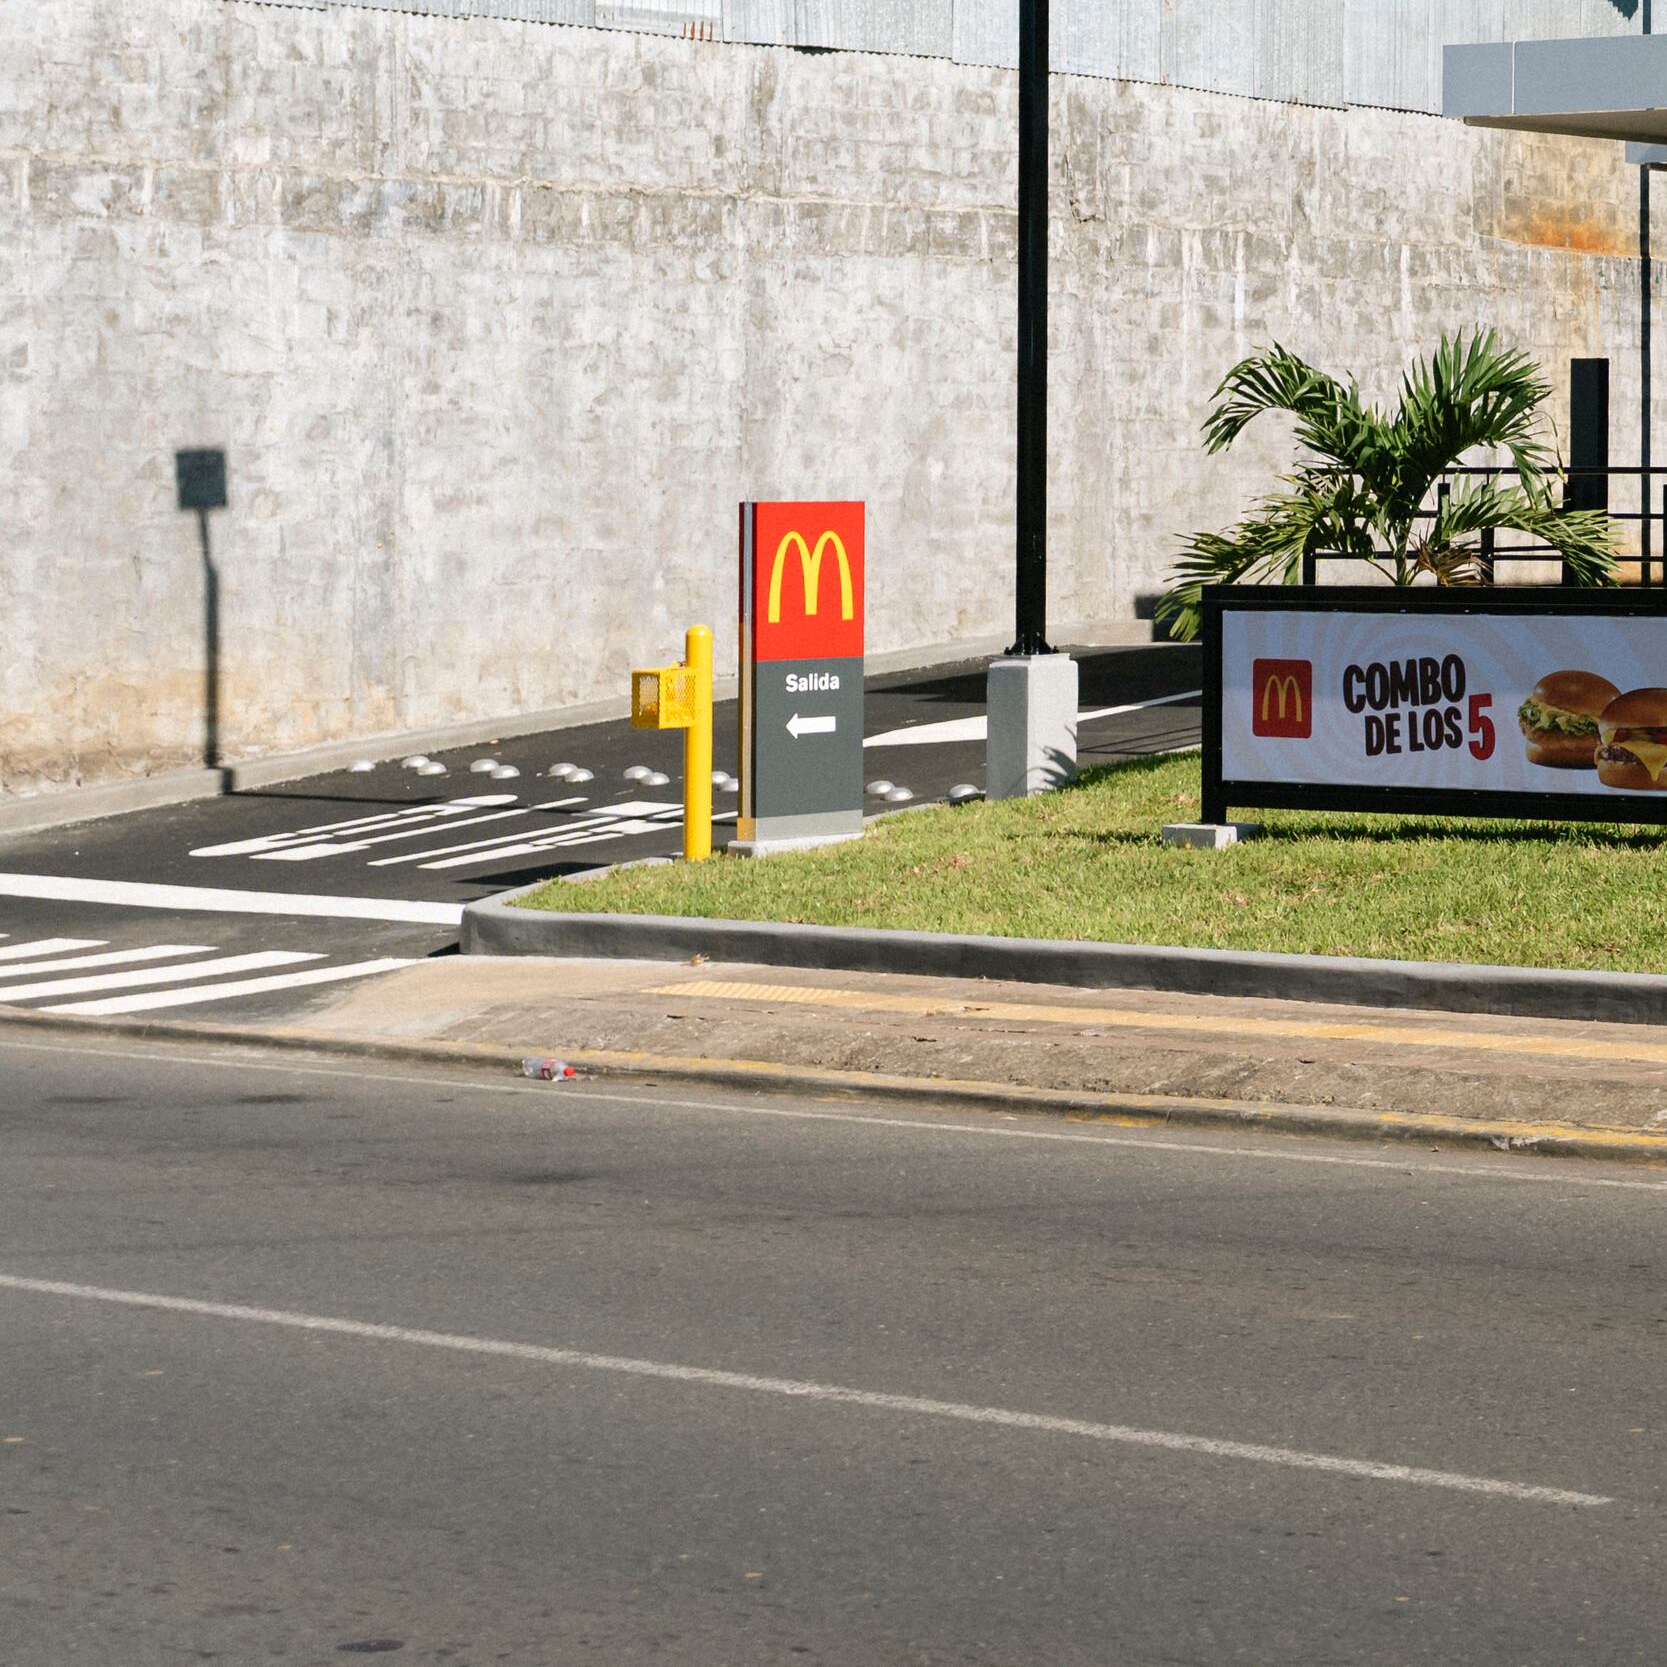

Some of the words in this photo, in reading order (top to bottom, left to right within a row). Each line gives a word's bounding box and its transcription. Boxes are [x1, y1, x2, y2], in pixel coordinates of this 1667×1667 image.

[785, 672, 841, 694] Salida
[1343, 653, 1467, 714] COMBO
[1365, 713, 1402, 756] DE
[1408, 706, 1463, 752] LOS
[1468, 693, 1496, 761] 5
